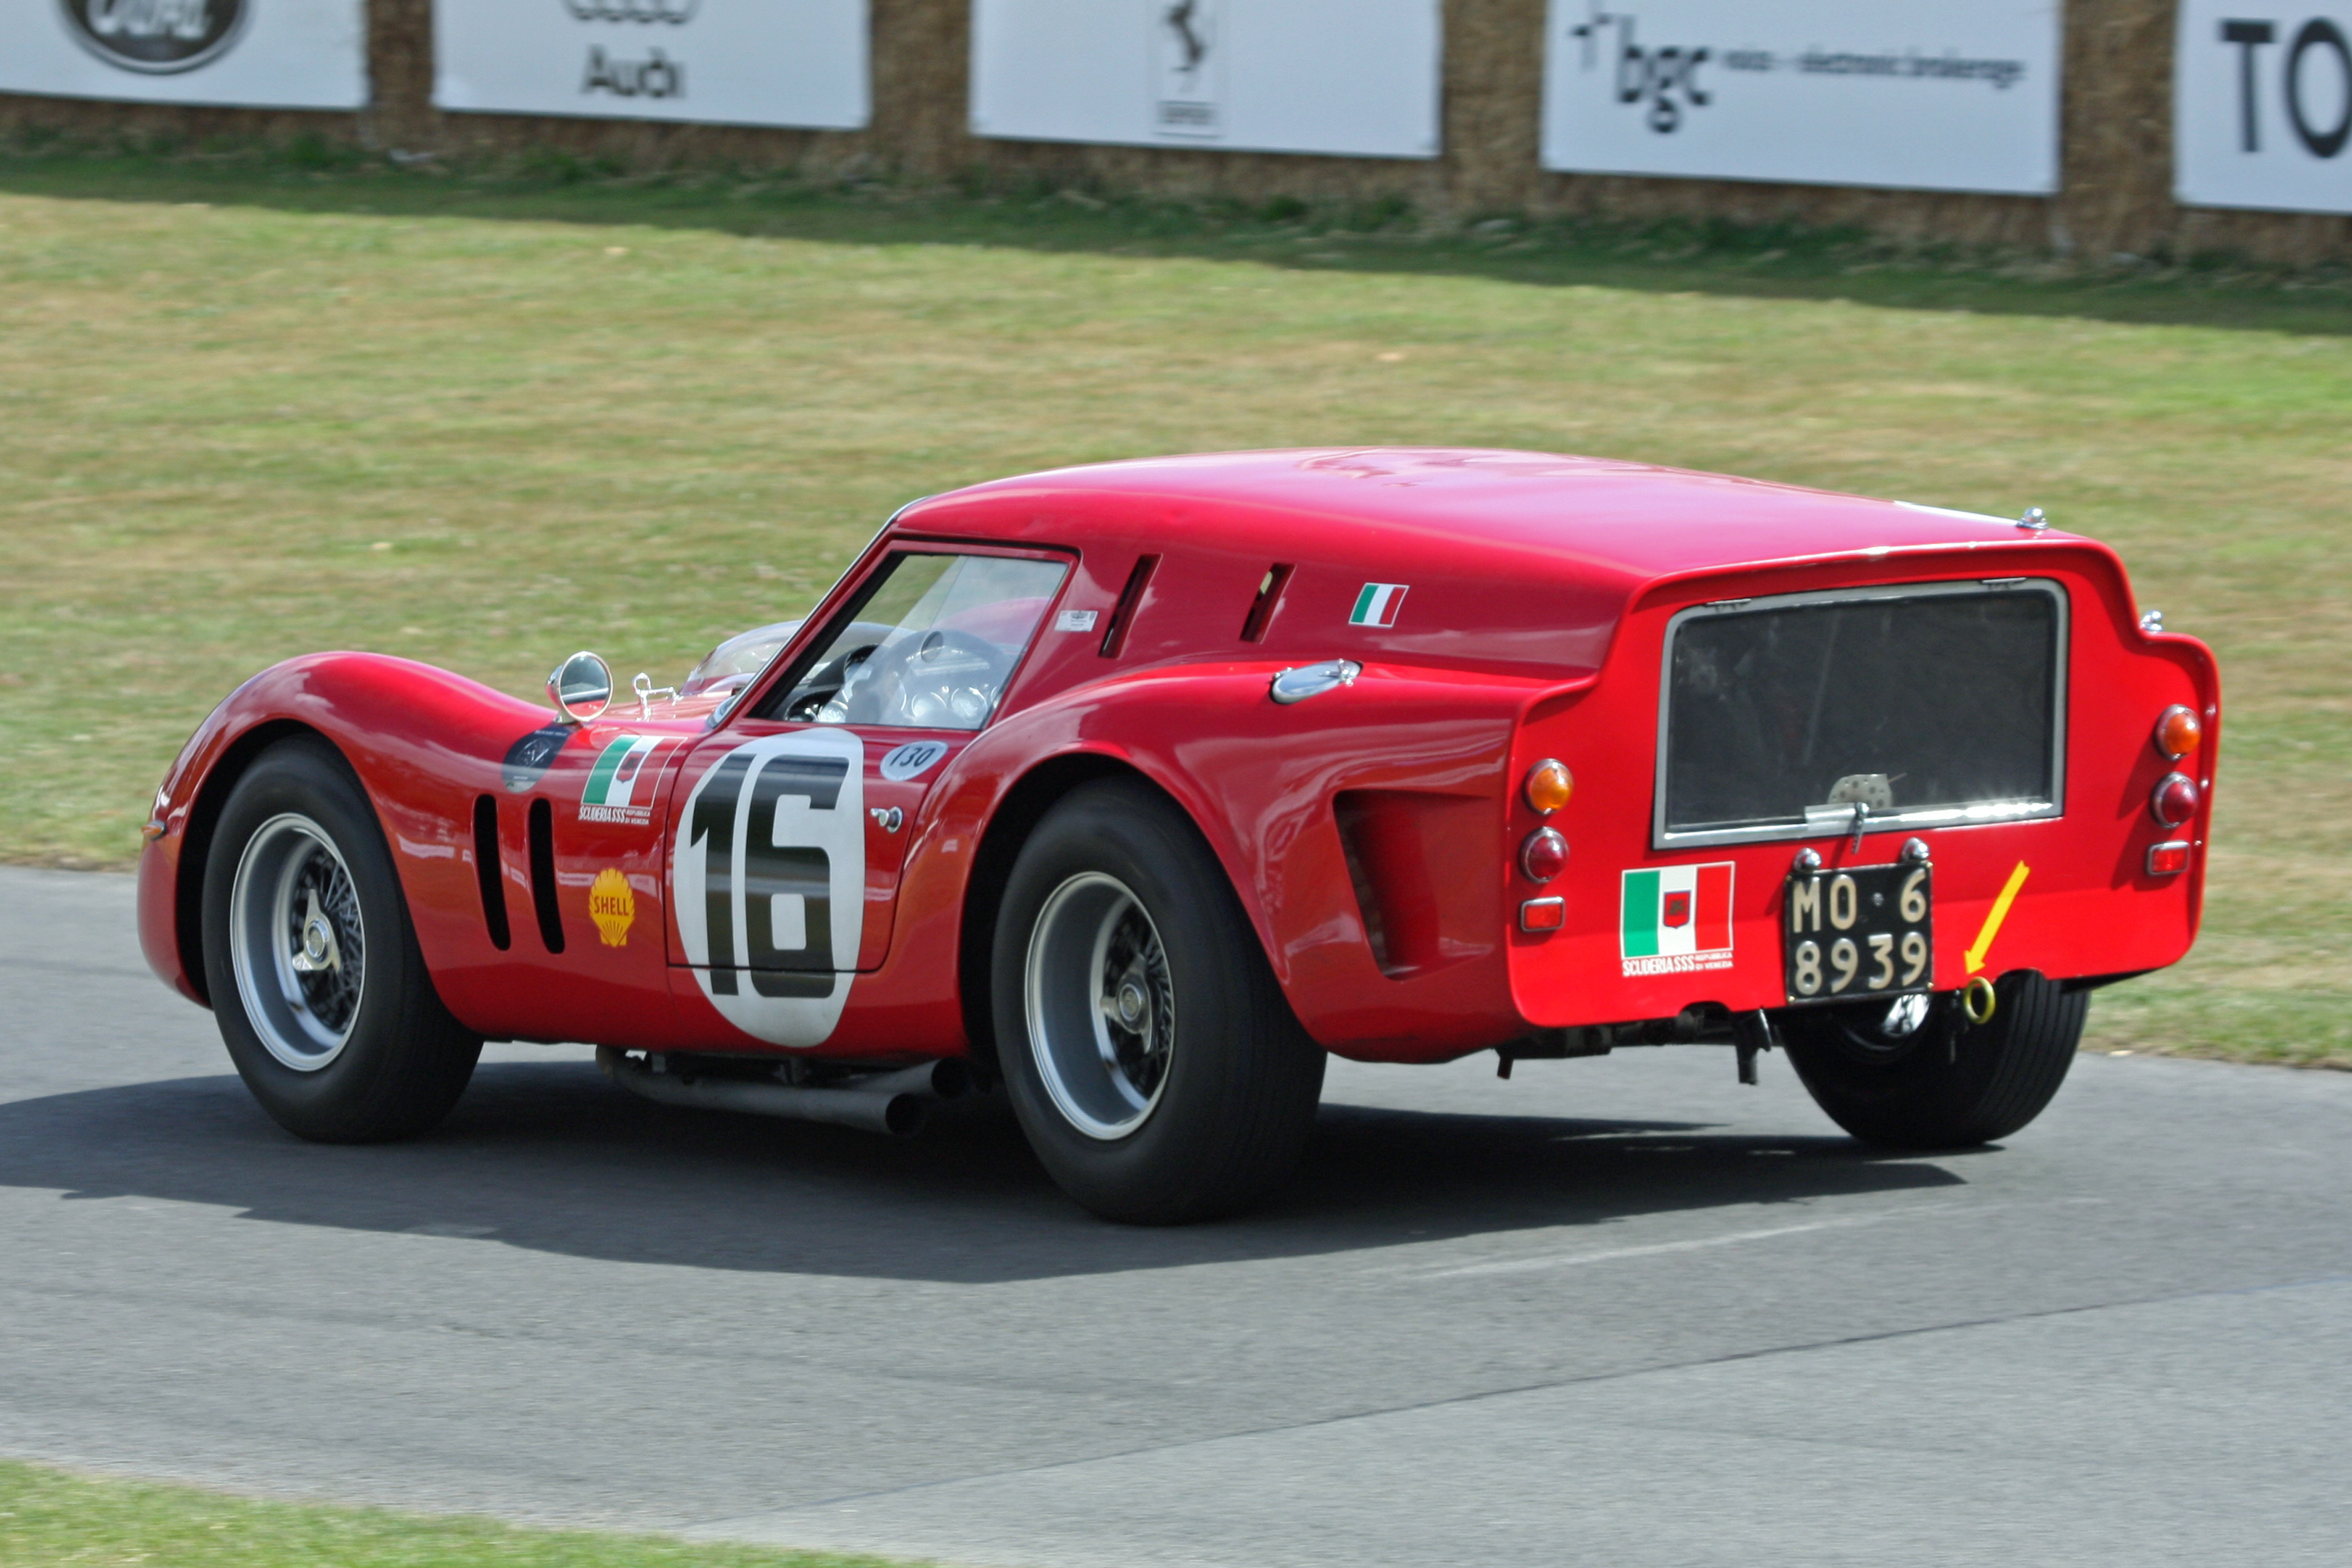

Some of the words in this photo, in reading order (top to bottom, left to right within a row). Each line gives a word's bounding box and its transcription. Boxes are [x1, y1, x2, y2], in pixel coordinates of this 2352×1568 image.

[581, 45, 686, 98] Audi
[1616, 15, 1711, 132] bgc
[890, 746, 936, 767] 130
[593, 896, 629, 916] SHELL
[690, 754, 850, 998] 16
[1792, 874, 1857, 933] MO
[1900, 868, 1926, 923] 6
[1794, 931, 1927, 996] 8939
